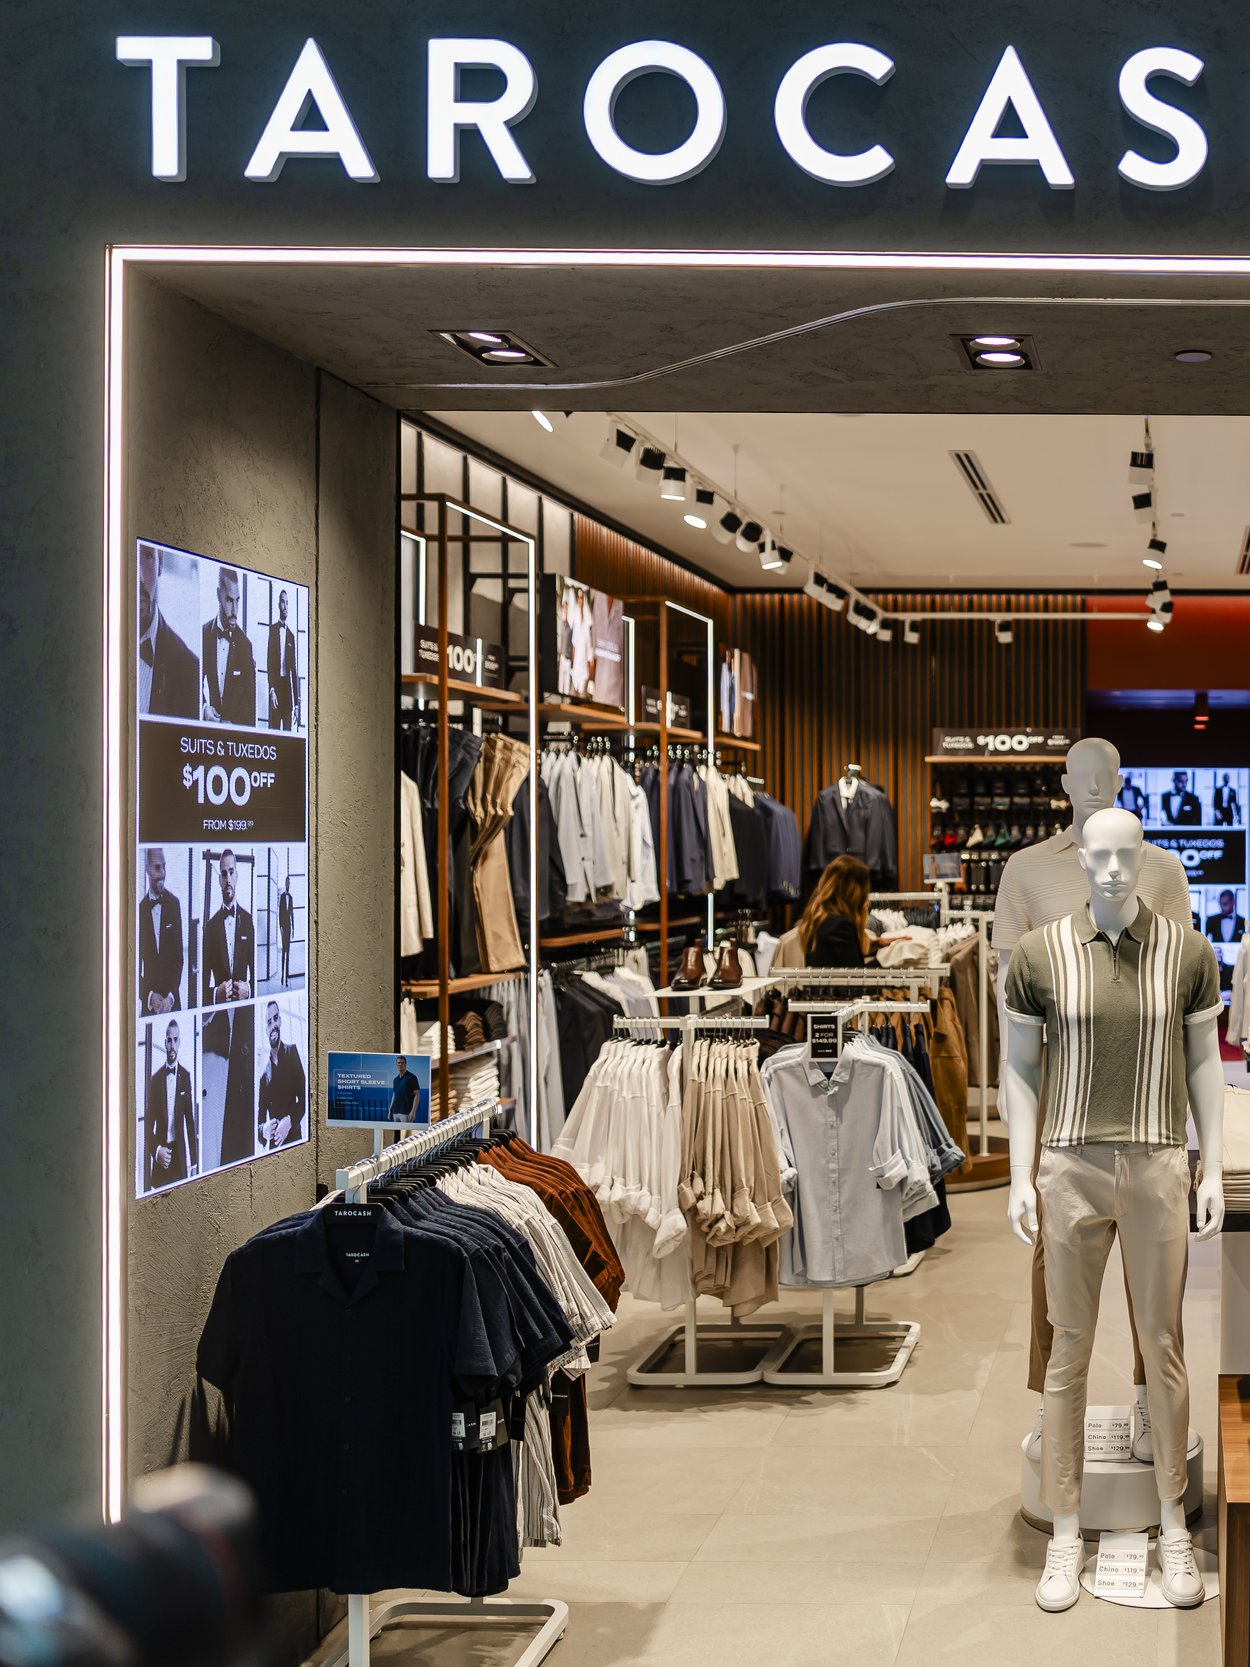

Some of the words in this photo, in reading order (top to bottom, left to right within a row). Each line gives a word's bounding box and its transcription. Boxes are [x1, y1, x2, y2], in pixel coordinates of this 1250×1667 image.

[180, 737, 214, 755] SUITS
[216, 741, 225, 756] &
[226, 741, 277, 760] TUXEDOS
[203, 819, 227, 830] FROM
